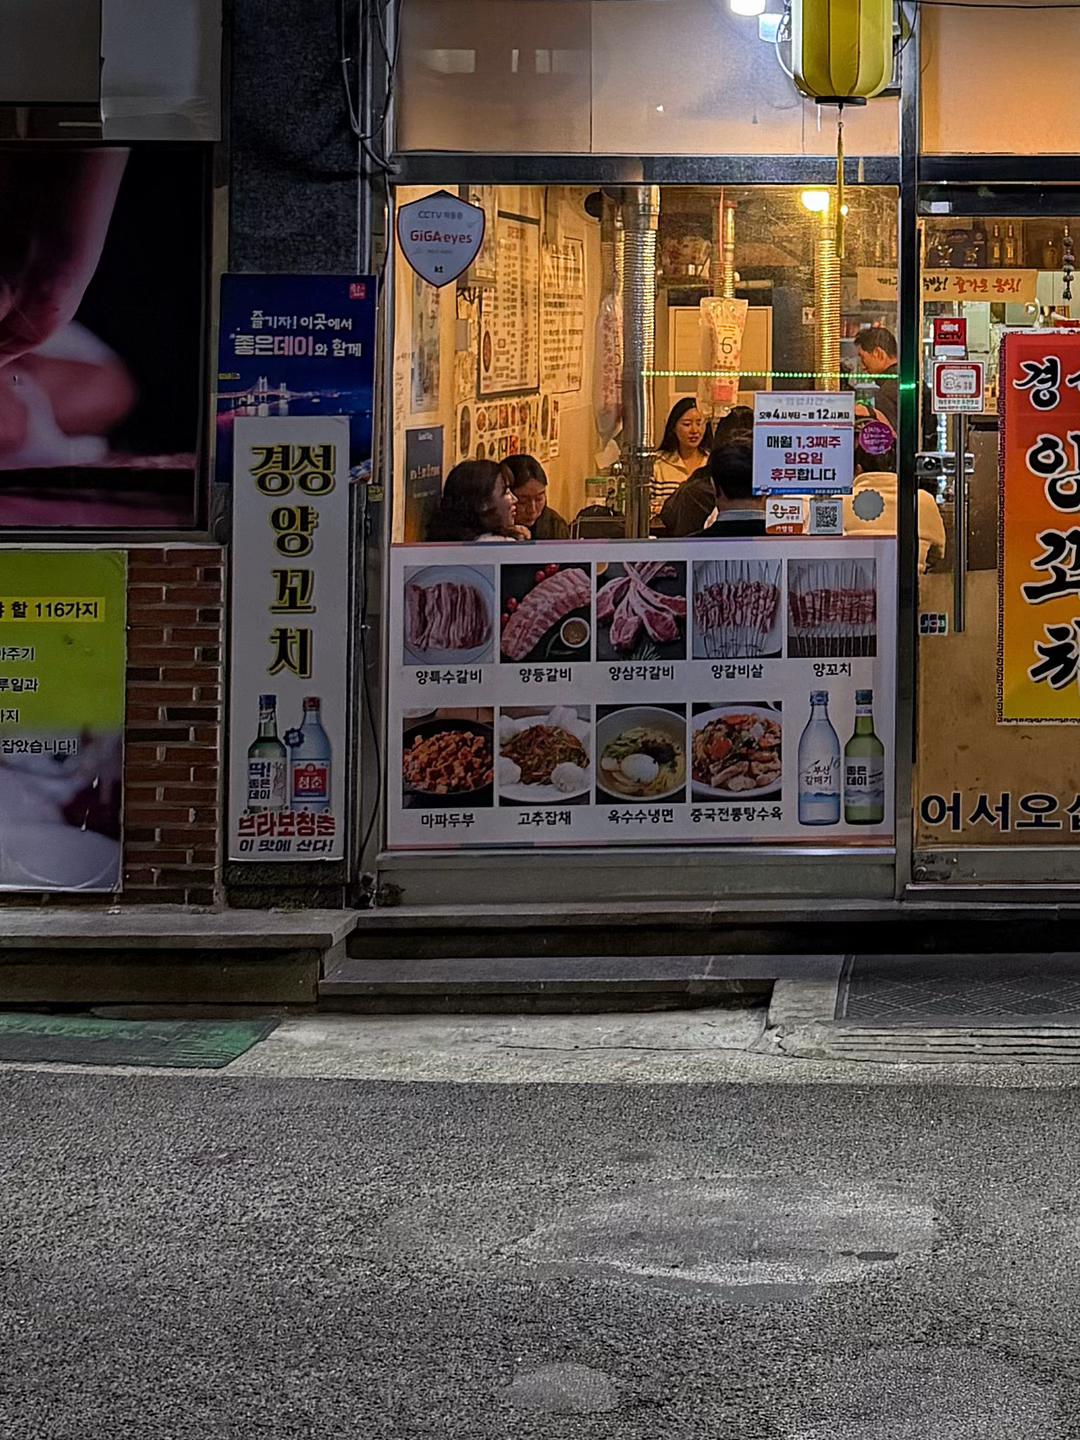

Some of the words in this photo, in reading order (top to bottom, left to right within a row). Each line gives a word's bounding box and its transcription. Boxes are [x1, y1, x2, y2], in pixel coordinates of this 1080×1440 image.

[251, 310, 296, 329] 즐기자!
[300, 313, 352, 330] 이곳에서
[234, 335, 328, 357] 좋은데이와
[332, 338, 362, 357] 함께
[767, 436, 792, 448] 매월
[784, 452, 823, 465] 일요일
[250, 444, 337, 495] 경성
[771, 468, 836, 481] 휴무합니다
[266, 505, 319, 680] 양꼬치
[12, 602, 28, 618] 할
[35, 602, 98, 618] 116가지
[416, 669, 482, 685] 양특수갈비
[519, 668, 572, 683] 양등갈비
[609, 666, 675, 681] 양삼각갈비
[711, 664, 764, 679] 양갈비살
[813, 662, 851, 677] 양꼬치
[2, 739, 78, 754] 잡았습니다!
[421, 812, 475, 829] 마파두부
[518, 810, 572, 826] 고추잡채
[608, 808, 674, 824] 옥수수냉면
[691, 806, 783, 823] 중국전통탕수육
[238, 811, 336, 837] 브라보청춘
[239, 840, 254, 852] 이
[258, 840, 291, 852] 맛에
[296, 840, 334, 852] 산다!
